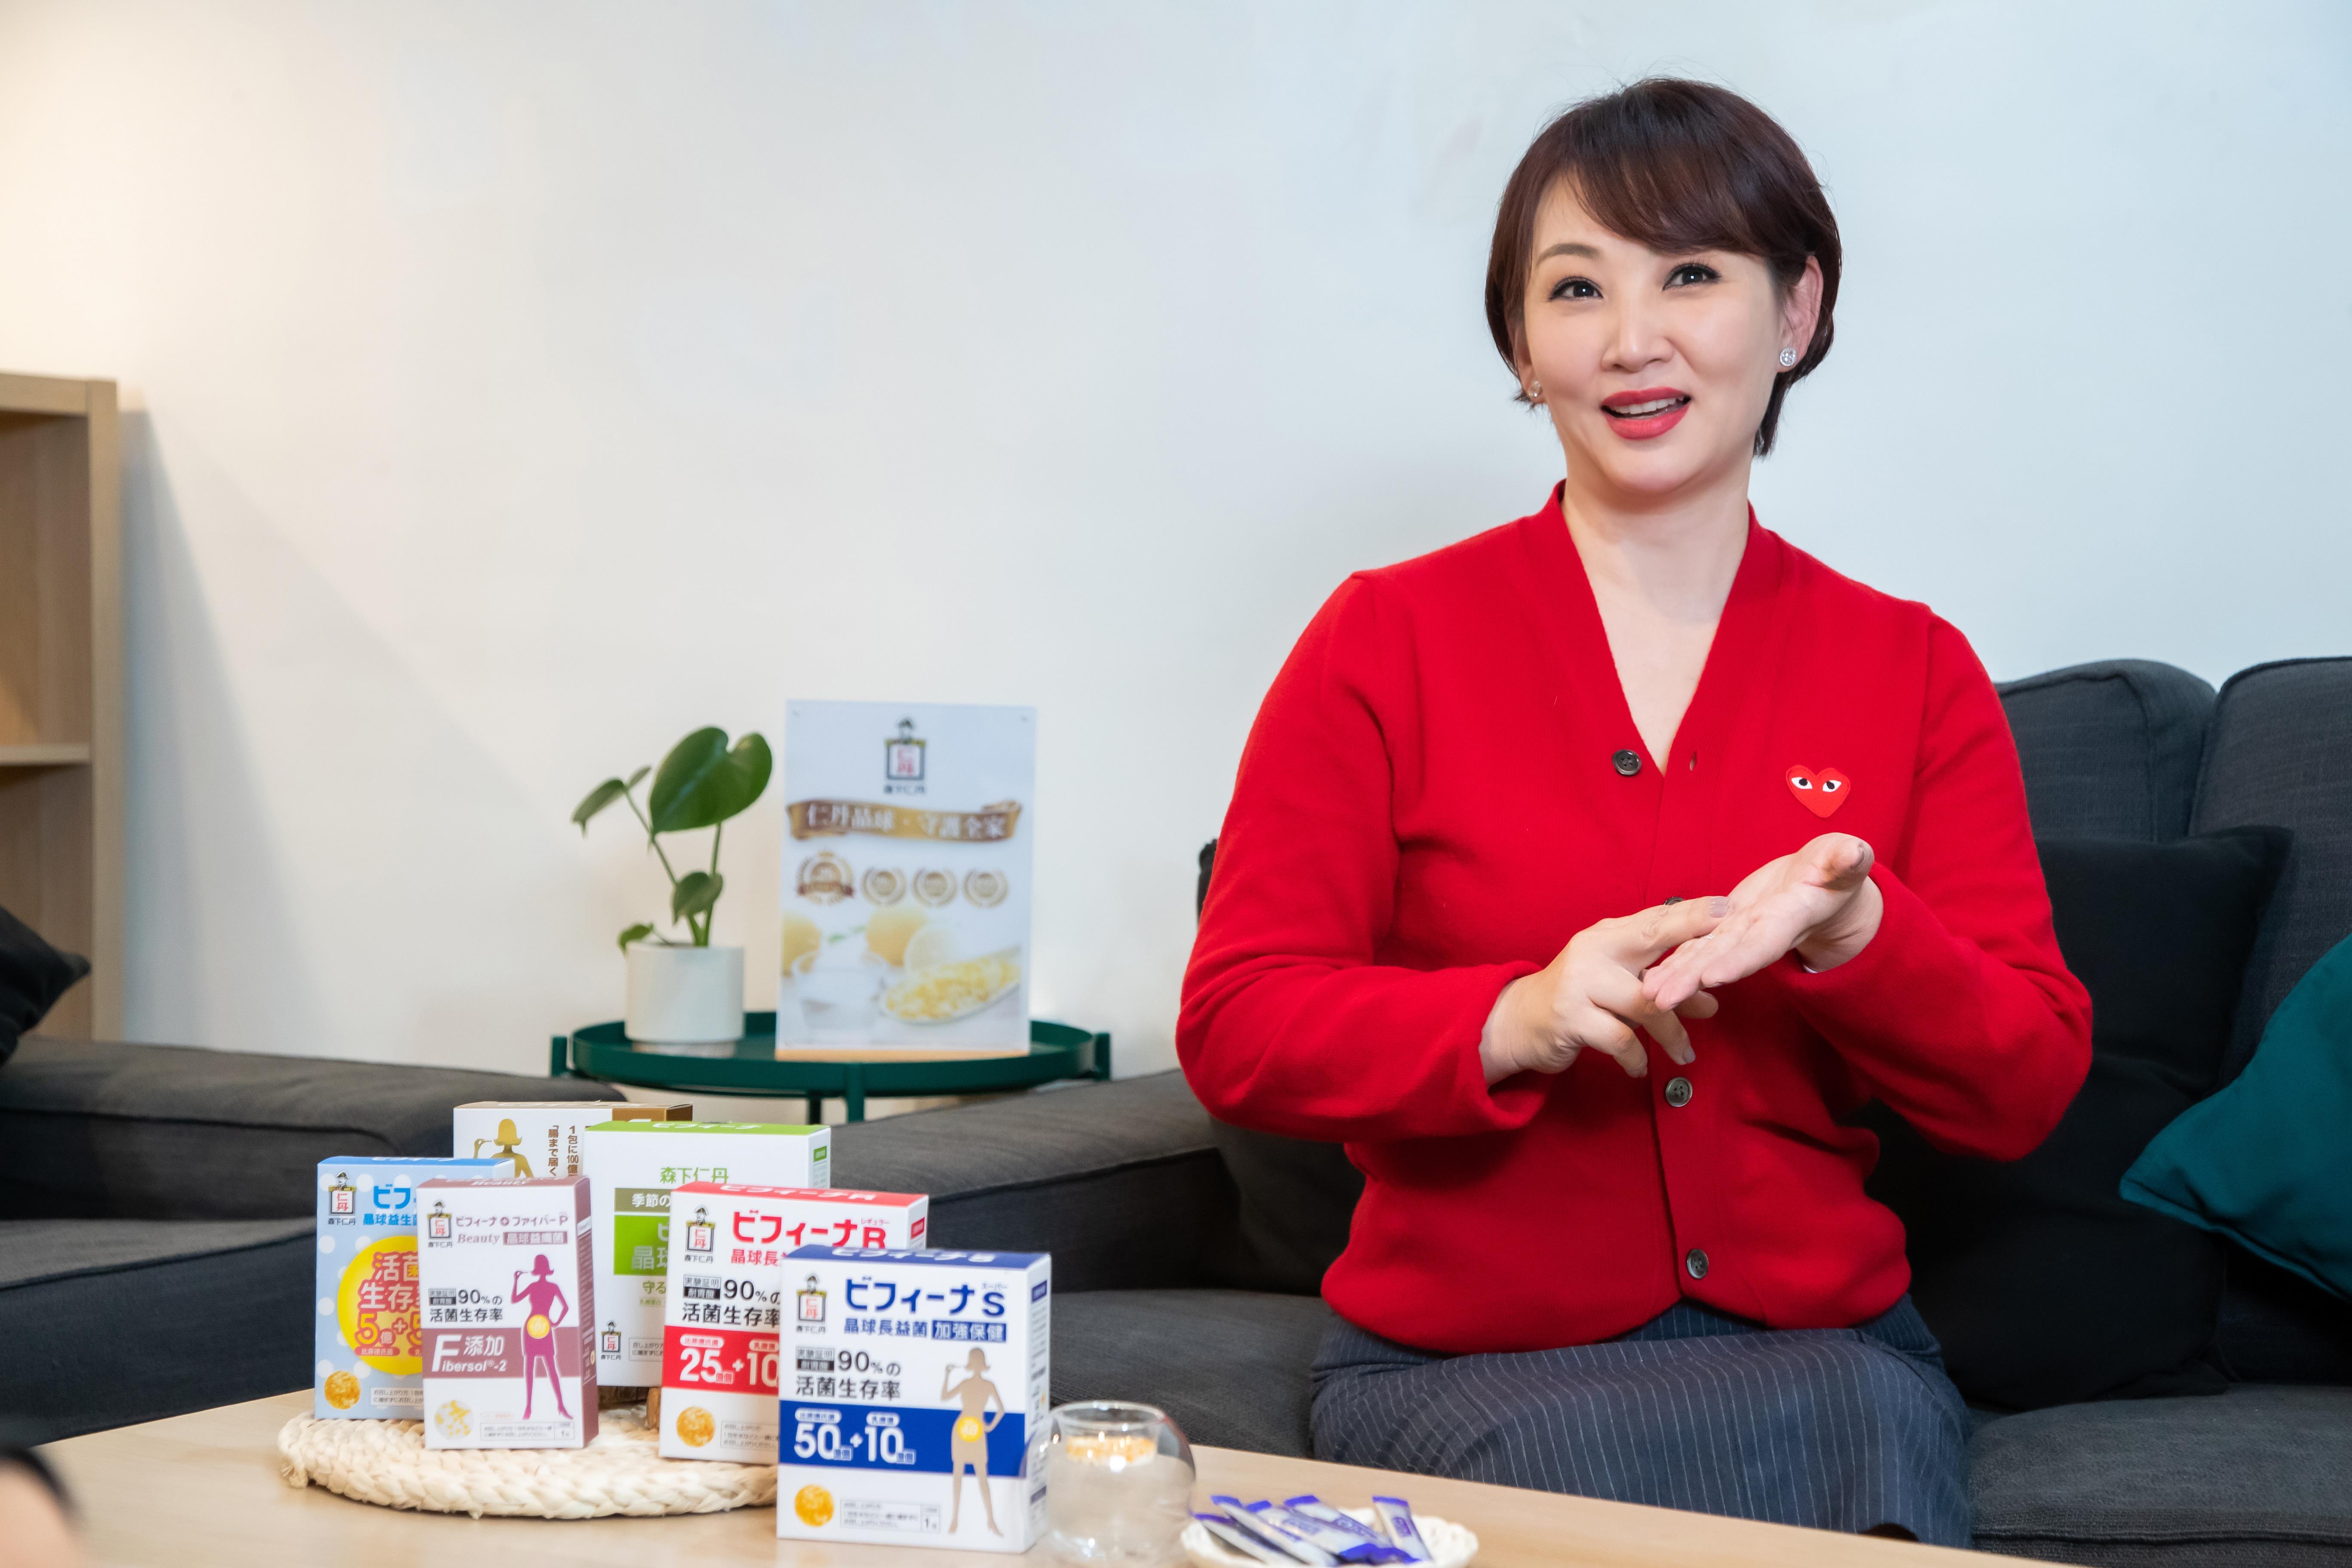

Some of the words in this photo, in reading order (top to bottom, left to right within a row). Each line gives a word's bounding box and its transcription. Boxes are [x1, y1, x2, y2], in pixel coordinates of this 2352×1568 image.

[566, 1125, 579, 1176] 1包に100億
[660, 1167, 729, 1184] 森下仁丹
[337, 1193, 349, 1211] 仁丹
[373, 1184, 416, 1209] ビフ
[632, 1193, 671, 1207] 季節の
[435, 1220, 445, 1236] 仁丹
[456, 1234, 499, 1244] Beauty
[694, 1229, 706, 1248] 仁丹
[684, 1254, 714, 1264] 森下仁丹
[731, 1248, 787, 1267] 晶球長
[360, 1282, 420, 1310] 生存
[642, 1280, 666, 1294] 守る
[845, 1276, 1005, 1317] ビフィーナS
[429, 1308, 503, 1323] 活菌生存率
[682, 1302, 780, 1328] 活菌生存率
[805, 1298, 818, 1319] 仁丹
[845, 1318, 928, 1338] 晶球長益菌
[607, 1336, 616, 1351] 仁丹
[796, 1375, 900, 1401] 活菌生存率
